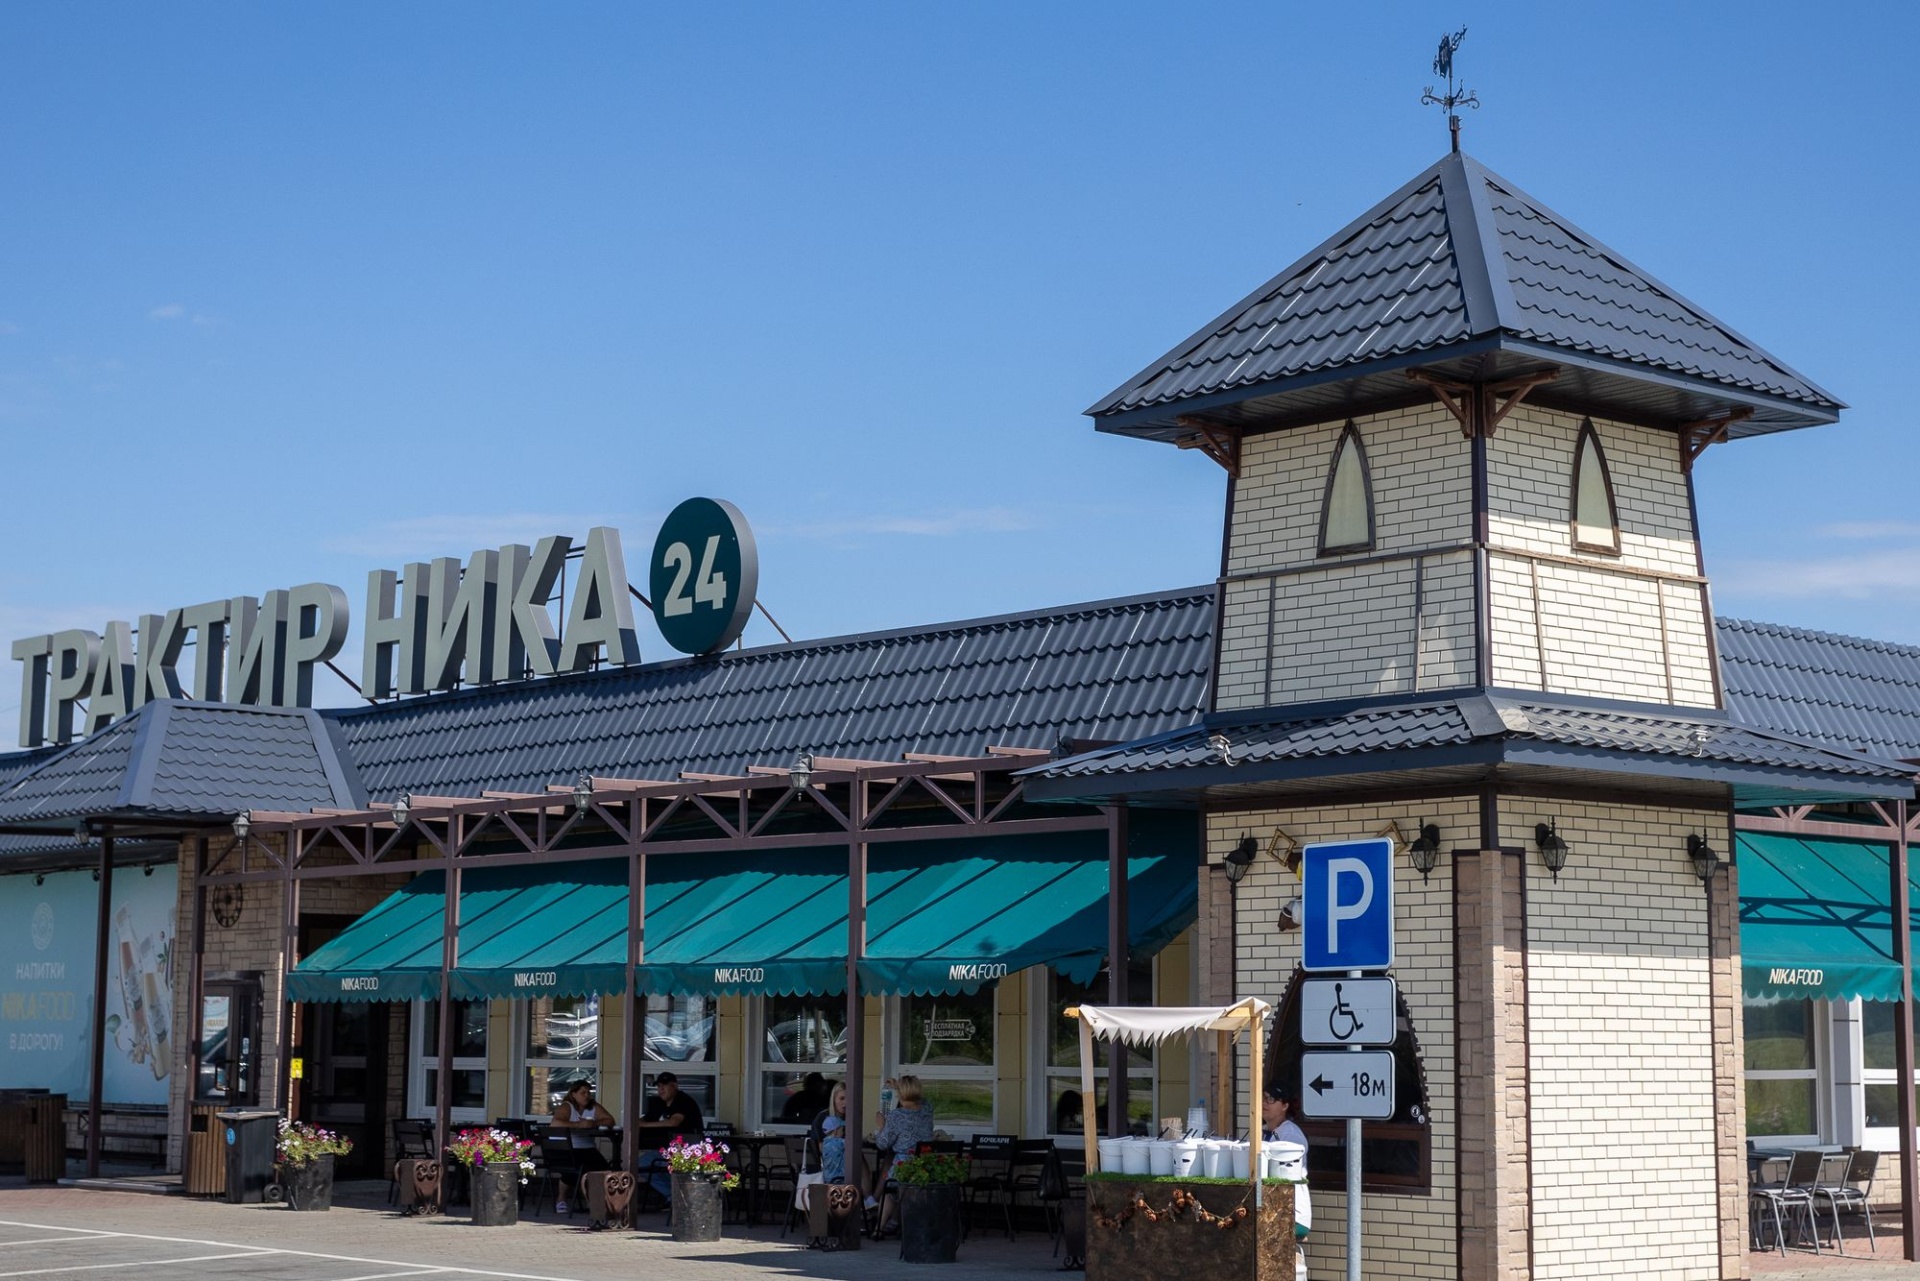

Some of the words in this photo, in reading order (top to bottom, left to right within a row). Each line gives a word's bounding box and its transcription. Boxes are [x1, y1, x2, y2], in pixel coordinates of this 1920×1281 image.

[12, 582, 350, 747] ТРАКТИР
[361, 526, 642, 699] НИКА
[663, 534, 727, 617] 24
[1328, 857, 1374, 954] P
[16, 963, 65, 980] НАПИТКИ
[514, 971, 557, 987] NIKAFOOD
[714, 967, 764, 983] NIKAFOOD
[1768, 968, 1824, 986] NIKAFOOD
[10, 1033, 17, 1050] В
[18, 1033, 63, 1052] ДОРОГУ!
